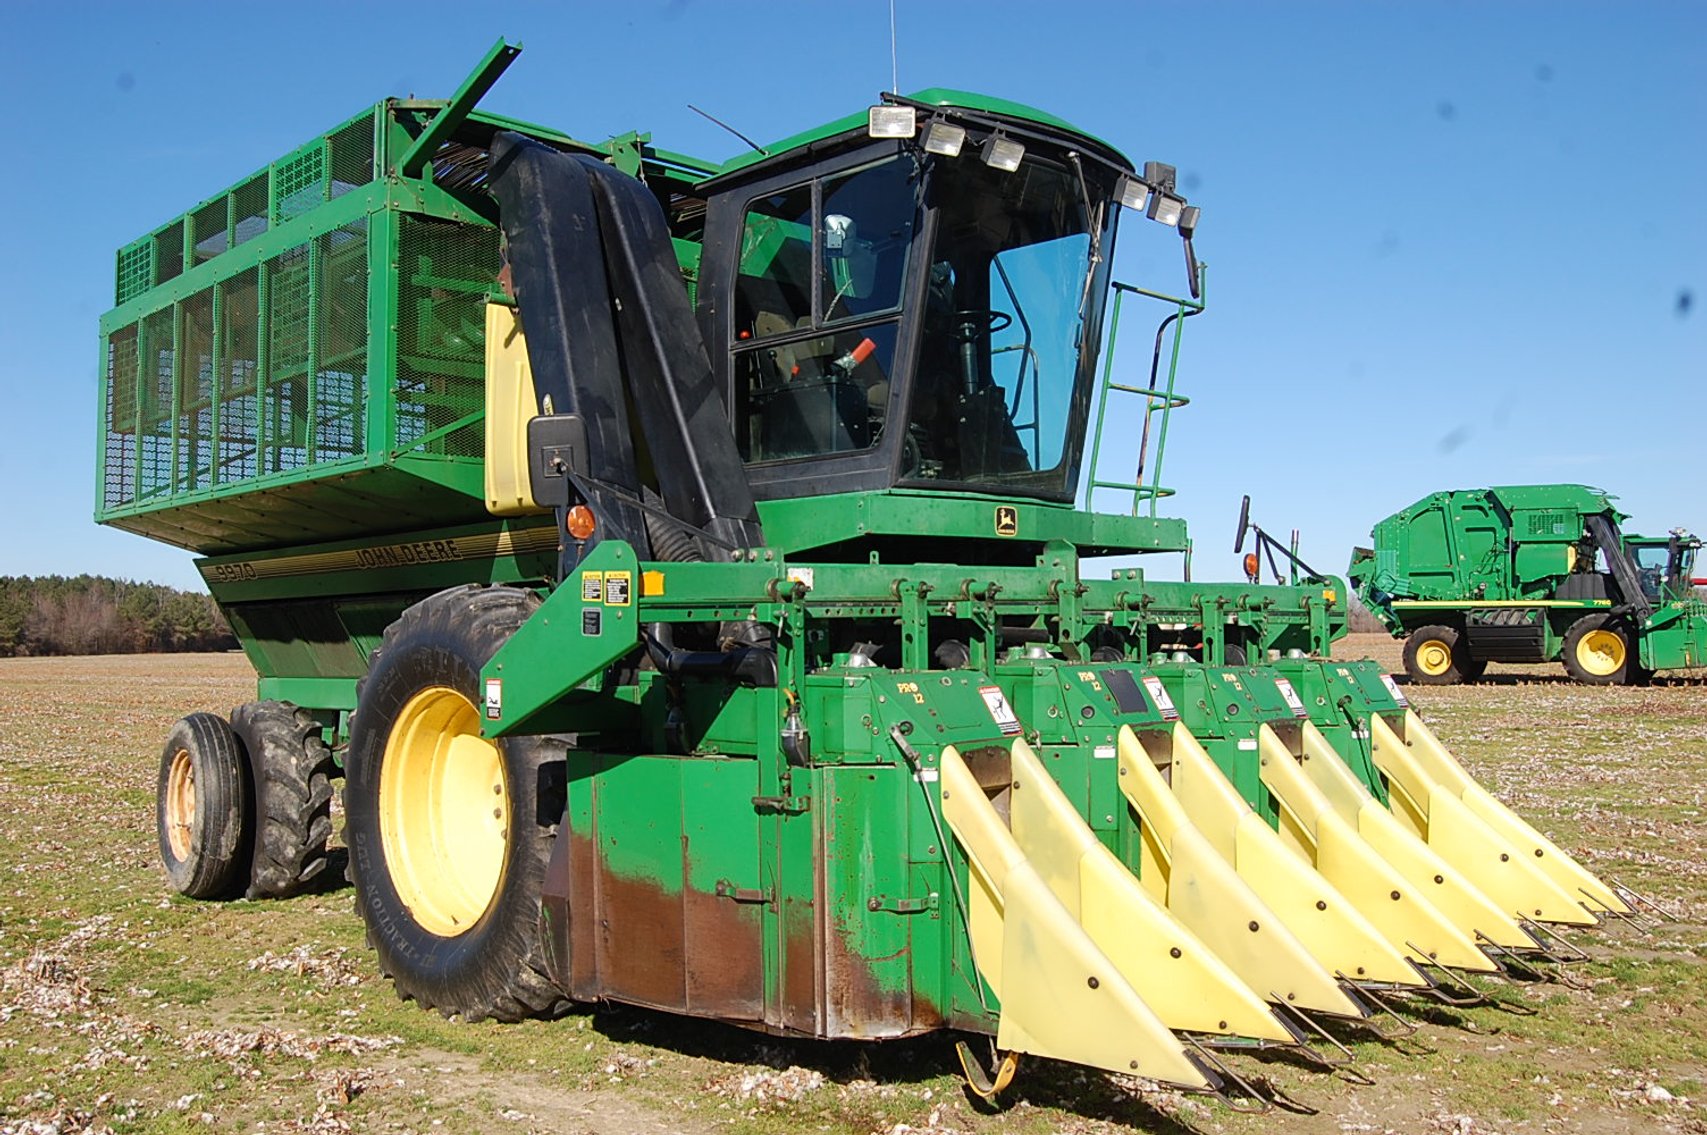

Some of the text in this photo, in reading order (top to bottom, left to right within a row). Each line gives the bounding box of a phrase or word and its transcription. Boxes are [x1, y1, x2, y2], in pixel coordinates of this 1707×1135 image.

[355, 540, 463, 569] JOHN DEERE
[215, 562, 257, 582] 9970
[896, 682, 919, 694] PRO
[912, 693, 925, 704] 12
